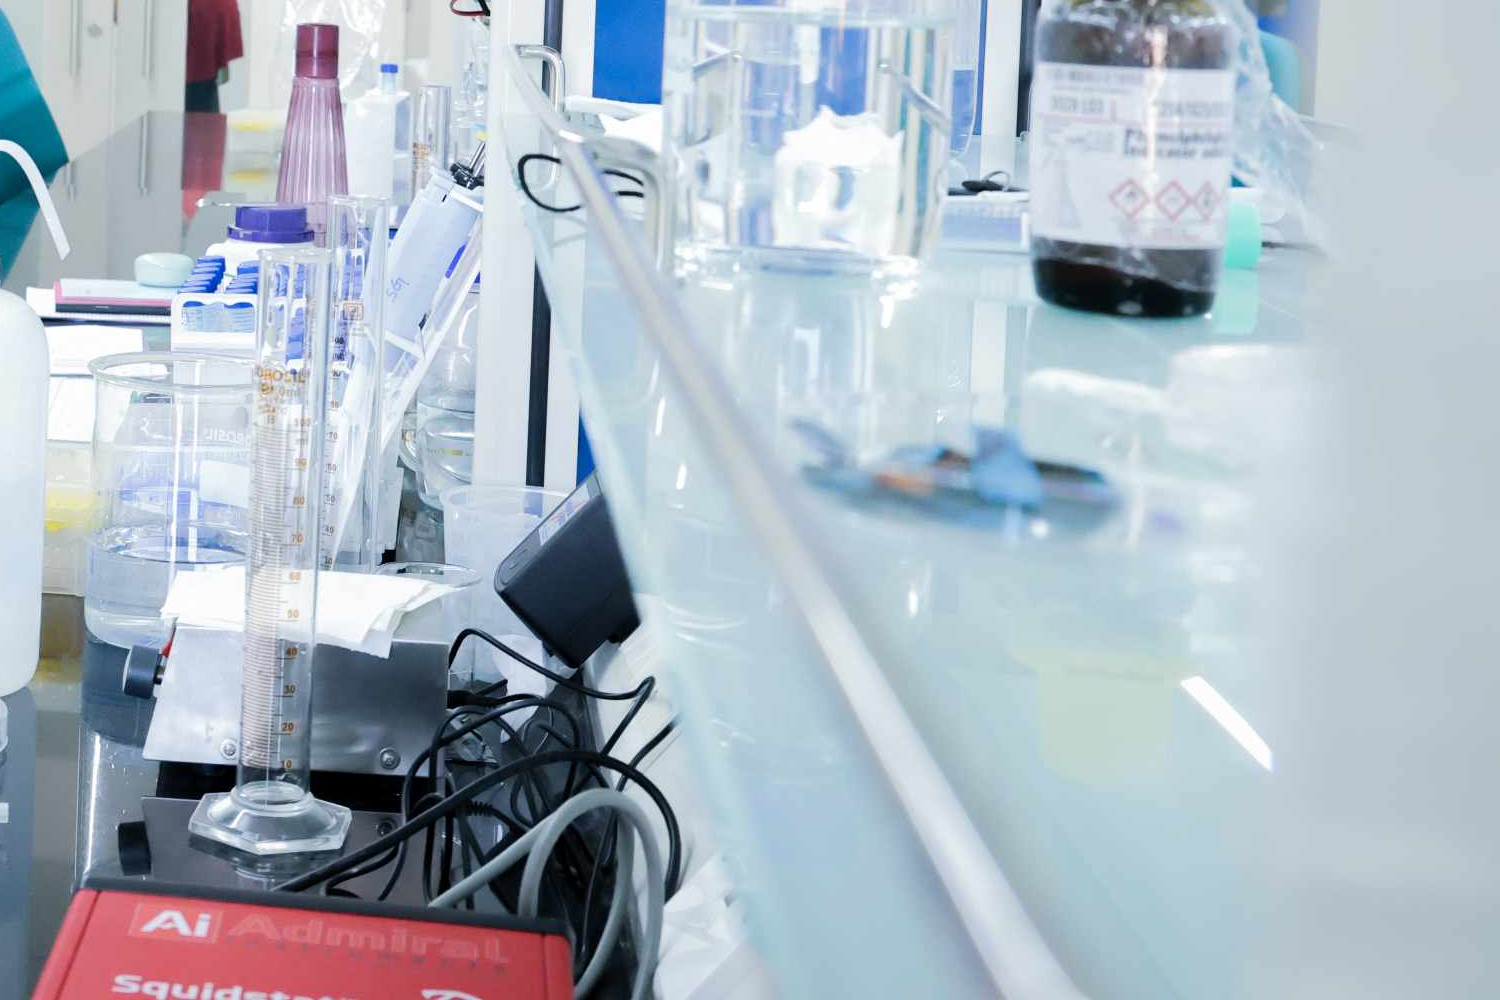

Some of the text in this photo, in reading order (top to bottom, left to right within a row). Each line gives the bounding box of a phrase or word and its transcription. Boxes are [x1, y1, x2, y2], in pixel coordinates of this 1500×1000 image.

[291, 533, 304, 544] 70
[287, 608, 300, 618] 50
[285, 647, 298, 657] 40
[283, 684, 296, 694] 30
[281, 722, 294, 732] 20
[281, 759, 293, 769] 10
[140, 908, 509, 964] Ai Admiral
